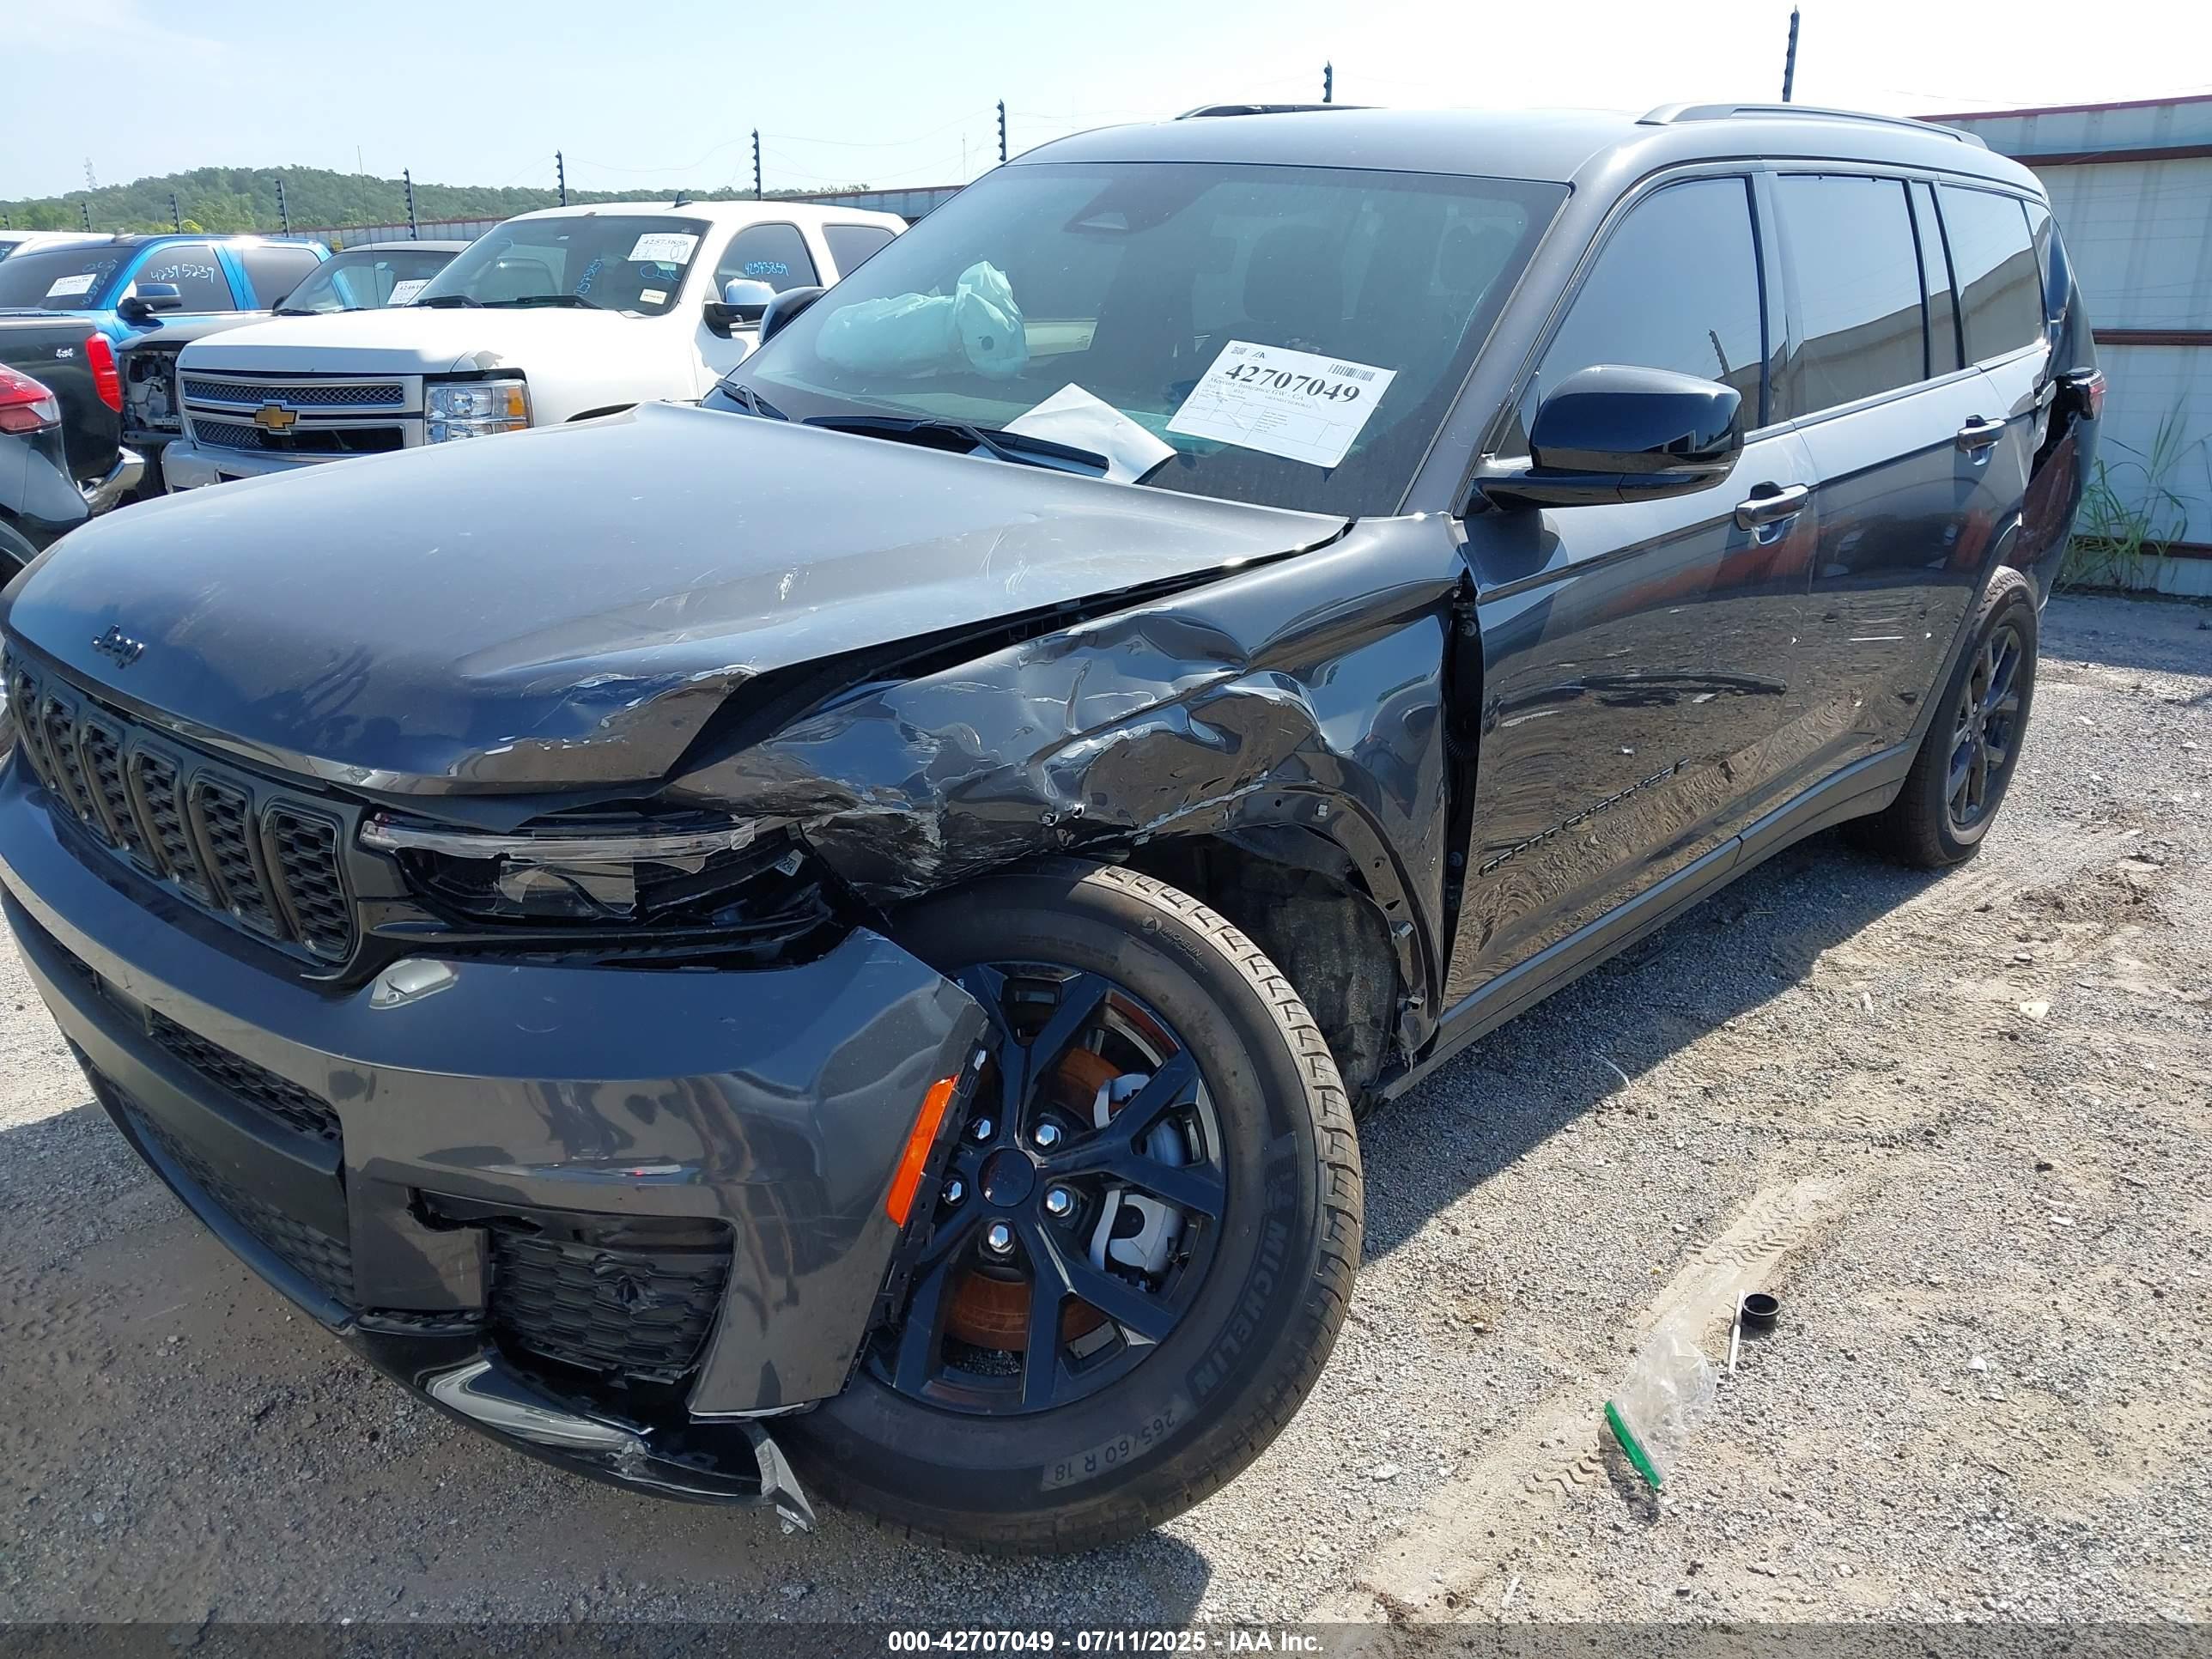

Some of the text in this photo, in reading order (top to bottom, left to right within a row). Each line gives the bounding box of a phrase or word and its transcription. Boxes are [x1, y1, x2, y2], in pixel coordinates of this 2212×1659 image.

[150, 263, 214, 283] 42395239
[744, 261, 789, 276] 42573859
[1225, 363, 1360, 403] 42707049
[93, 624, 145, 670] Jeep
[1159, 927, 1203, 957] MICHELIN
[1194, 1219, 1288, 1396] MICHELIN
[1054, 1408, 1176, 1482] 265/60 R 18
